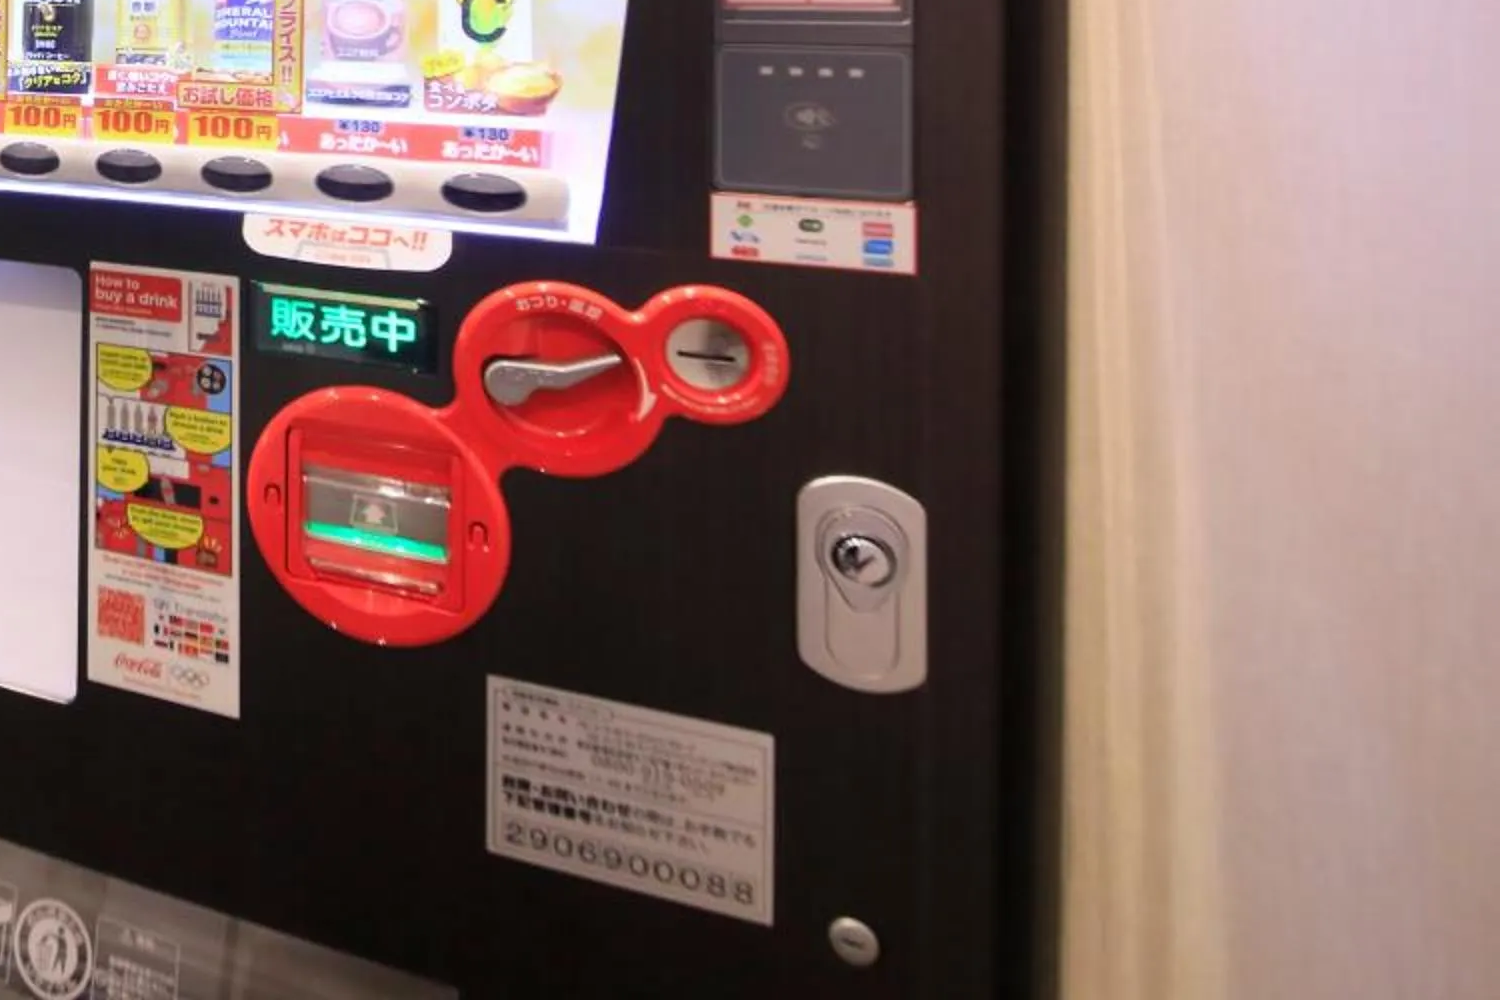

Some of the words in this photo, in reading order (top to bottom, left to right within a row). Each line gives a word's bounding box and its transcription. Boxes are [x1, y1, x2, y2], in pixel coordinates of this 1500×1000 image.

[183, 87, 274, 107] お試し価格
[10, 106, 77, 129] 100円
[97, 110, 171, 135] 100円
[193, 116, 273, 141] 100円
[95, 274, 124, 289] How
[127, 277, 140, 291] to
[95, 287, 123, 304] buy
[139, 292, 179, 309] drink
[269, 296, 418, 353] 販売中
[505, 820, 755, 906] 2906900088
